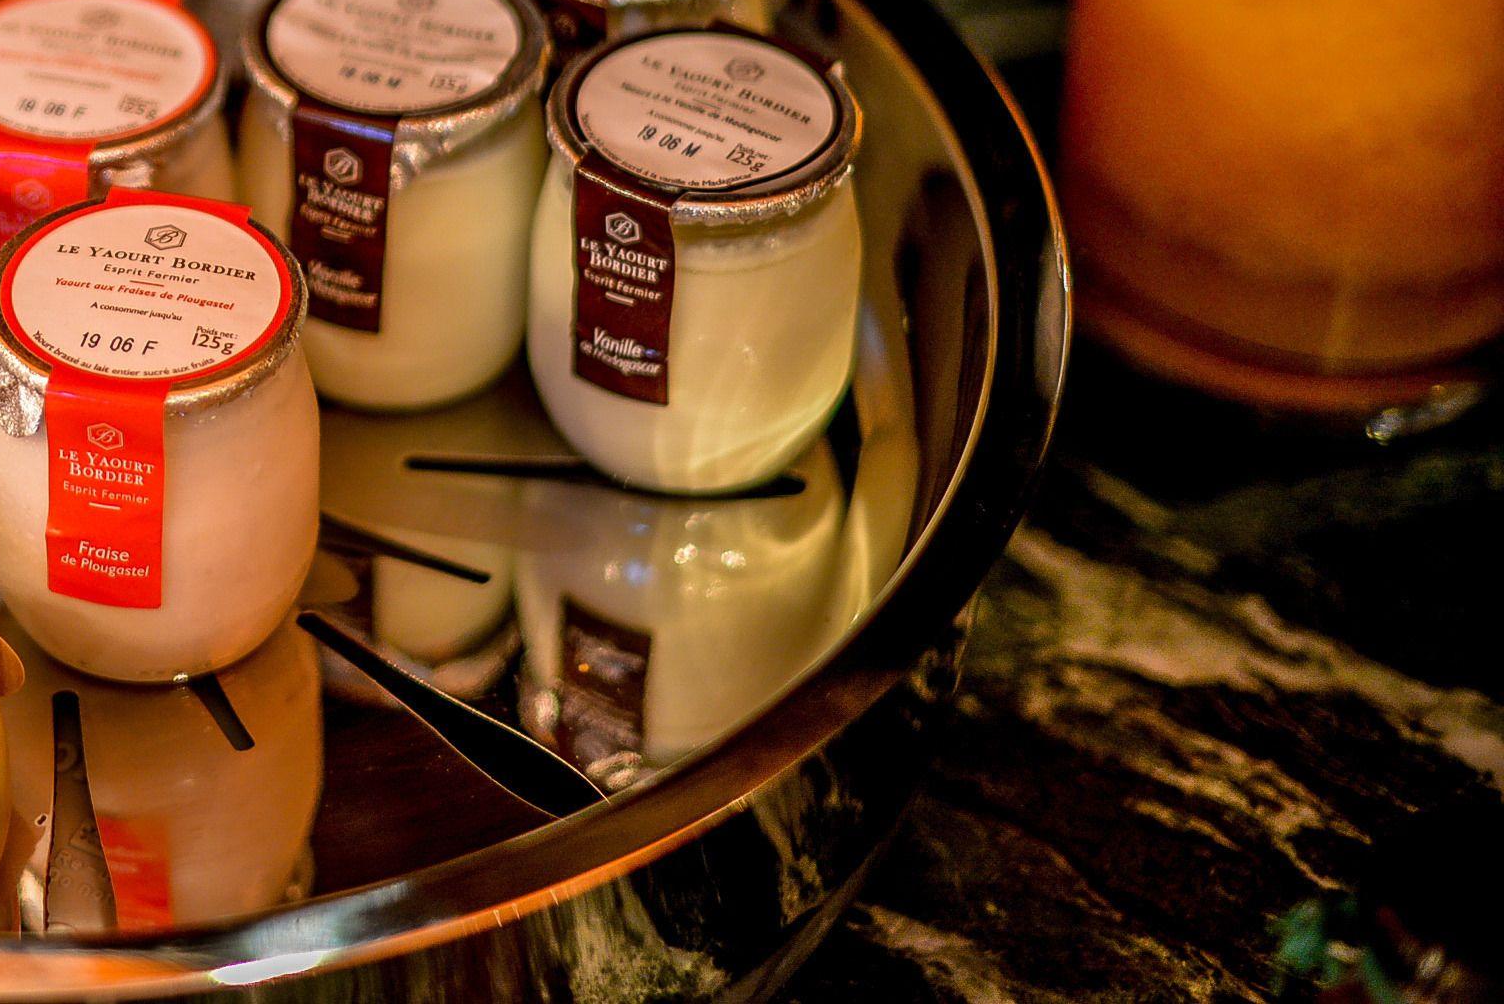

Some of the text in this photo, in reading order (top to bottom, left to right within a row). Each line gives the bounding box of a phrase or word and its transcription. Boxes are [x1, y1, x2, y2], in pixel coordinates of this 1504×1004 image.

[739, 88, 811, 124] BORDIER
[637, 124, 702, 158] 19 06 M
[57, 244, 256, 281] LE YAOURT BORDIER
[581, 237, 667, 271] LE YAOURT
[590, 251, 657, 283] BORDIER
[104, 264, 200, 284] Esprit Fermier
[584, 268, 661, 300] Esprit Fermier
[56, 277, 235, 311] Yaourt aux Fraises de Plougastel
[90, 301, 183, 322] A consommer jusqu'au
[80, 331, 159, 355] 19 06 F
[196, 325, 218, 336] Poids
[593, 327, 643, 357] Vanille
[93, 363, 109, 373] lait
[112, 369, 141, 377] entier
[143, 367, 170, 376] sucré
[172, 366, 190, 374] aux
[190, 357, 215, 370] fruits
[58, 448, 154, 475] LE YAOURT
[69, 462, 144, 486] BORDIER
[63, 480, 149, 504] Esprit Fermier
[79, 540, 130, 562] Fraise
[61, 553, 150, 578] de Plougastel
